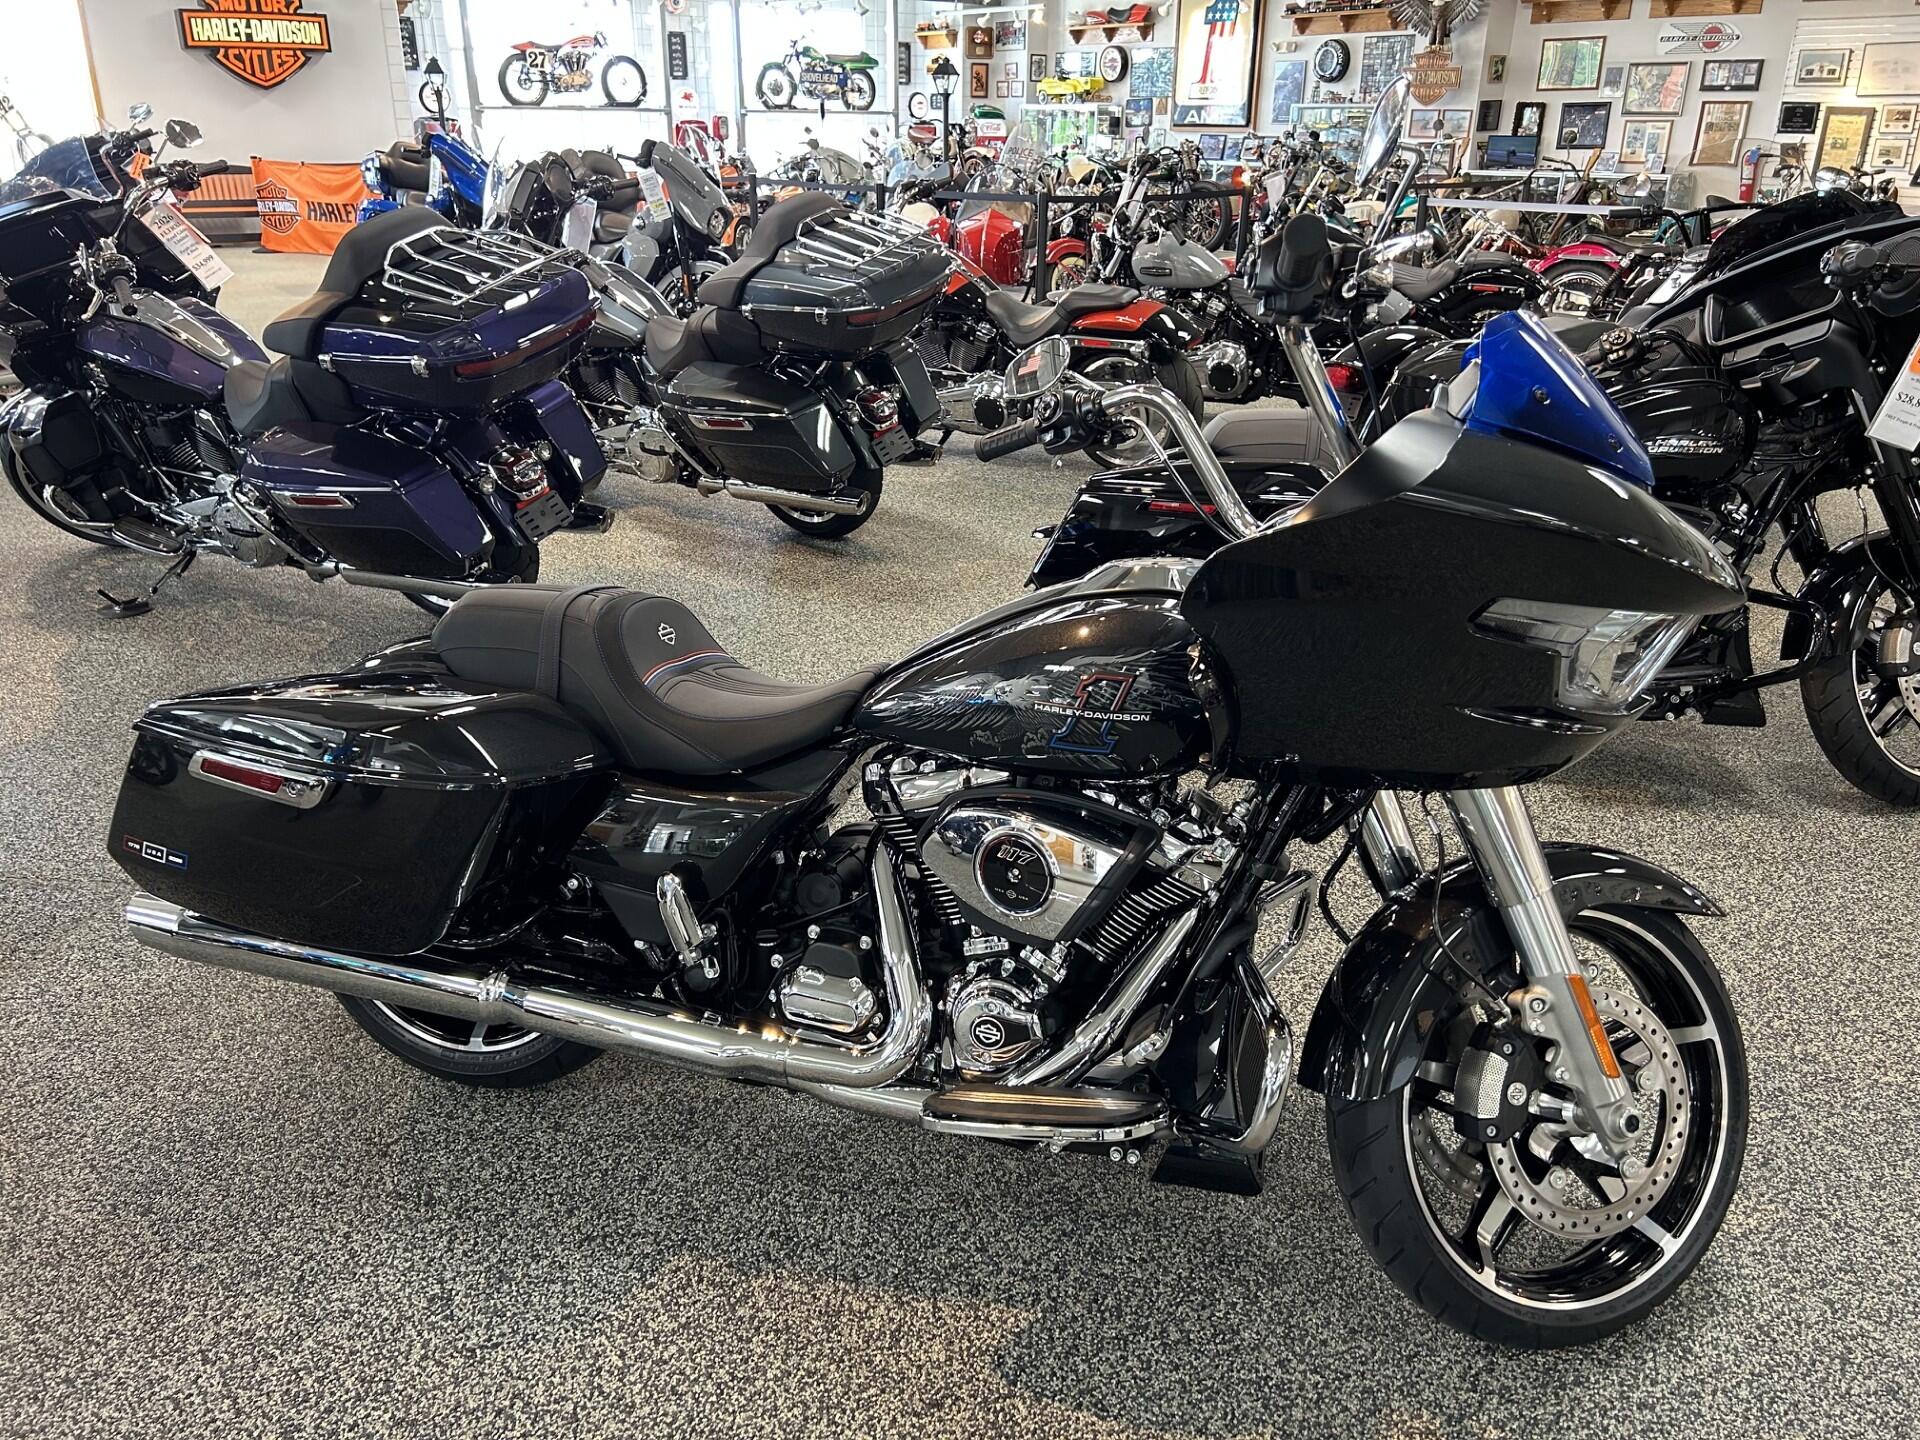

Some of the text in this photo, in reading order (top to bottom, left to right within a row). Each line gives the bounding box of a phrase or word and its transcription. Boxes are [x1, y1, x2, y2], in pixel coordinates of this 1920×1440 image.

[190, 17, 322, 44] HARLEY-DAVIDSON
[228, 49, 295, 80] CYCLES
[528, 51, 547, 69] 27
[1008, 146, 1034, 157] POLICE
[154, 213, 174, 229] 2026
[306, 201, 359, 223] HARLEY
[1034, 703, 1150, 721] HARLEY-DAVIDSON
[997, 844, 1038, 865] 117
